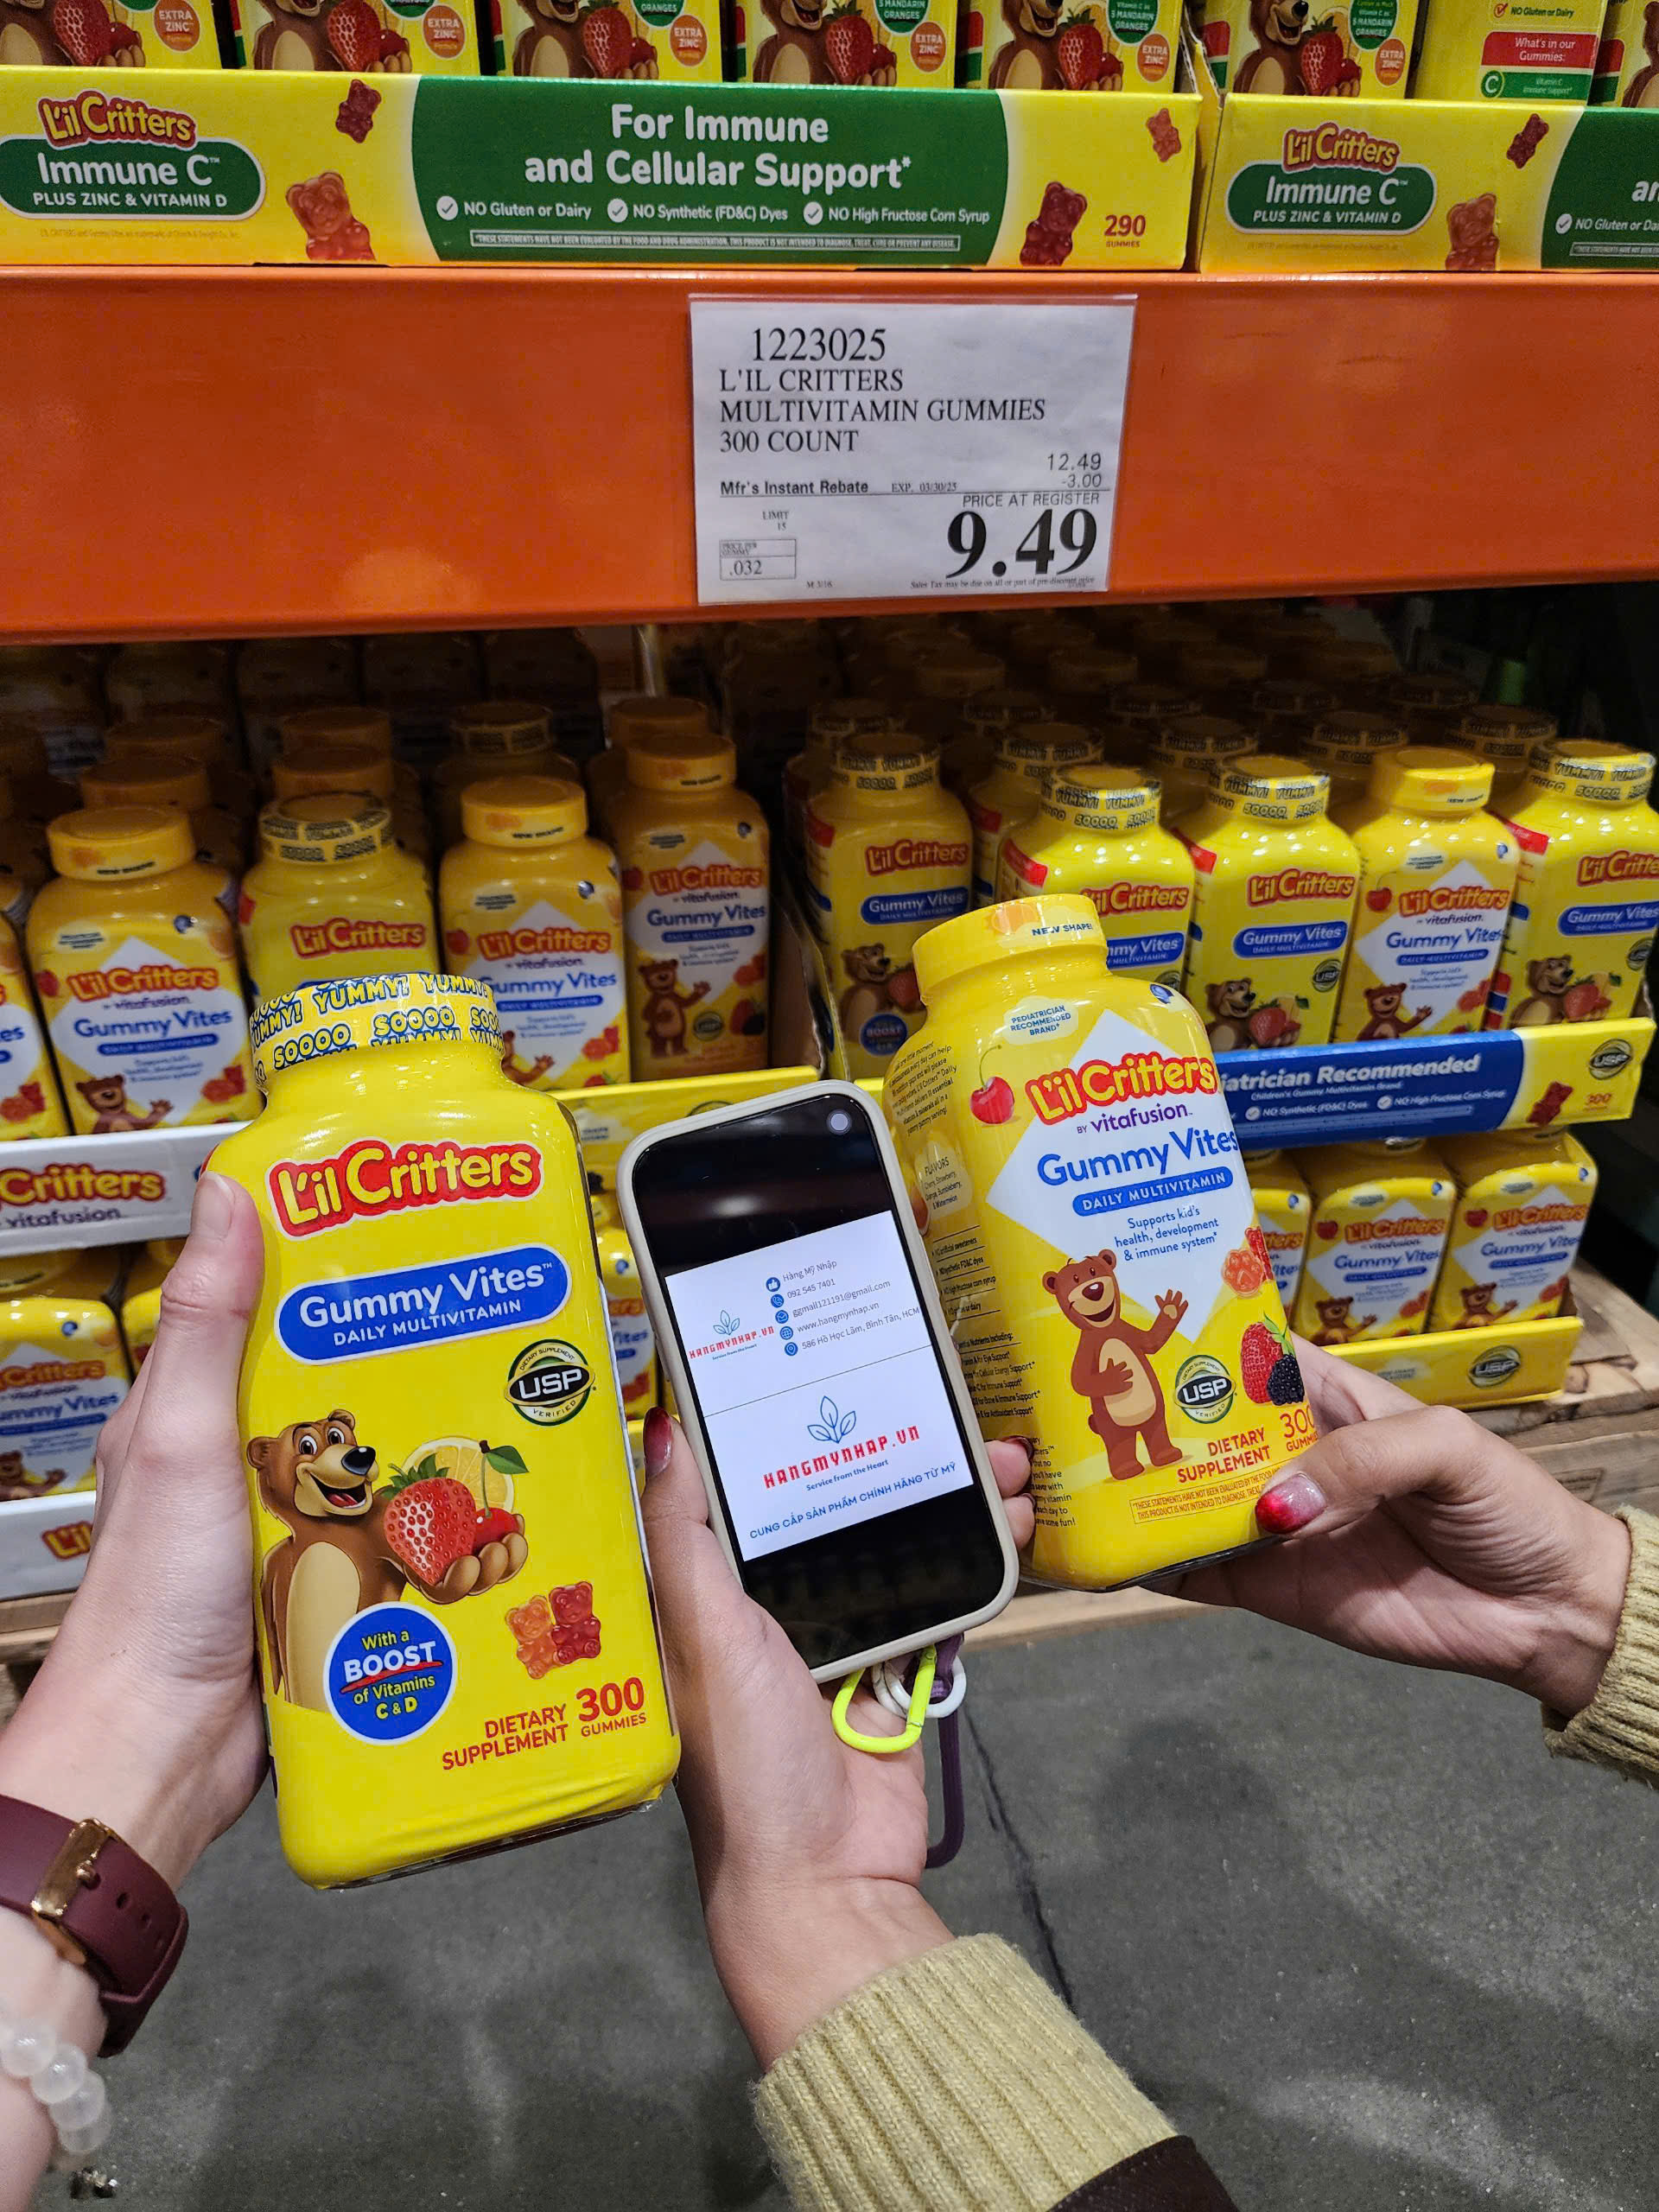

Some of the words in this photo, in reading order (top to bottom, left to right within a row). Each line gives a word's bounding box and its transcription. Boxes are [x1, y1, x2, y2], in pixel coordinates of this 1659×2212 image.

[159, 10, 192, 22] EXTRA
[1516, 38, 1546, 48] What's
[1548, 40, 1557, 48] in
[1520, 51, 1566, 61] Gummies:
[1485, 75, 1499, 93] C
[42, 101, 79, 140] L'il
[81, 96, 191, 142] Critters
[612, 104, 674, 138] For
[685, 106, 828, 142] Immune
[1314, 128, 1398, 165] Critters
[38, 153, 177, 185] Immune
[525, 149, 594, 184] and
[606, 151, 744, 187] Cellular
[33, 193, 76, 206] PLUS
[82, 193, 120, 207] ZINC
[125, 194, 137, 207] &
[143, 194, 211, 207] VITAMIN
[216, 194, 226, 207] D
[1267, 177, 1372, 205] Immune
[464, 201, 486, 216] NO
[490, 202, 534, 217] Gluten
[538, 206, 552, 217] or
[556, 203, 591, 220] Dairy
[633, 205, 654, 219] NO
[658, 205, 711, 222] Synthetic
[715, 207, 756, 222] (FD&C)
[760, 207, 787, 221] Dyes
[829, 207, 849, 220] NO
[853, 207, 877, 224] High
[881, 208, 926, 222] Fructose
[930, 208, 955, 222] Corn
[958, 208, 989, 225] Syrup
[1103, 214, 1146, 237] 290
[1106, 240, 1140, 249] GUMMIES
[752, 327, 886, 362] 1223025
[721, 369, 771, 392] L'IL
[779, 369, 904, 392] CRITTERS
[720, 399, 918, 423] MULTIVITAMIN
[927, 399, 1046, 421] GUMMIES
[720, 430, 760, 453] 300
[768, 429, 860, 453] COUNT
[1047, 453, 1102, 471] 12.49
[721, 481, 759, 494] Mfr's
[765, 482, 814, 494] Instant
[820, 480, 868, 494] Rebate
[1062, 474, 1102, 488] -3.00
[963, 494, 1002, 507] PRICE
[1008, 494, 1025, 506] AT
[1033, 493, 1099, 505] REGISTER
[762, 511, 789, 520] LIMIT
[946, 509, 1096, 579] 9.49
[729, 560, 762, 575] .032
[894, 842, 966, 867] Critters
[1280, 873, 1354, 898] Critters
[868, 898, 923, 913] Gummy
[926, 892, 964, 906] Vites
[1032, 926, 1059, 936] NEW
[1063, 923, 1092, 931] SHAPE!
[1243, 930, 1300, 946] Gummy
[1306, 926, 1341, 938] Vites
[107, 969, 218, 992] Critters
[73, 1018, 171, 1038] Gummy
[173, 1010, 232, 1027] Vites
[373, 1005, 455, 1038] SOOOO
[1010, 1013, 1071, 1031] RECOMMENDED
[1012, 1005, 1065, 1024] PEDIATRICIAN
[1317, 1054, 1480, 1085] Recommended
[1031, 1072, 1082, 1119] L'il
[1082, 1057, 1215, 1101] Critters
[1077, 1125, 1087, 1134] BY
[1038, 1143, 1169, 1185] Gummy
[1169, 1128, 1237, 1160] Vites
[1, 1168, 163, 1205] Critters
[277, 1162, 341, 1226] L'il
[346, 1147, 533, 1205] Critters
[1082, 1192, 1122, 1211] DAILY
[1128, 1172, 1225, 1201] MULTIVITAMIN
[7, 1207, 121, 1229] vitafusion
[1128, 1213, 1175, 1230] Supports
[1177, 1205, 1200, 1219] kid's
[1115, 1232, 1154, 1248] health,
[1155, 1218, 1219, 1239] development
[1124, 1249, 1133, 1261] &
[1136, 1243, 1179, 1258] immune
[783, 1269, 804, 1281] Hàng
[787, 1289, 801, 1299] 092
[803, 1285, 817, 1294] 545
[818, 1279, 836, 1289] 7401
[299, 1283, 444, 1329] Gummy
[797, 1302, 880, 1332] www.hangmynhap.vn
[334, 1325, 388, 1346] DAILY
[392, 1299, 521, 1335] MULTIVITAMIN
[802, 1339, 816, 1349] 586
[902, 1307, 919, 1319] HCM
[690, 1325, 774, 1359] HANGMYNHAP.VN
[520, 1351, 537, 1370] DIETARY
[539, 1348, 575, 1360] SUPPLEMENT
[518, 1369, 582, 1399] USP
[1183, 1378, 1227, 1402] USP
[533, 1400, 575, 1417] VERIFIED
[1207, 1427, 1265, 1457] DIETARY
[763, 1426, 919, 1489] HANGMYNHAP.VN
[1177, 1446, 1271, 1483] SUPPLEMENT
[807, 1478, 832, 1491] Service
[834, 1471, 853, 1482] from
[854, 1467, 867, 1477] the
[867, 1459, 888, 1471] Heart
[750, 1522, 780, 1539] CUNG
[362, 1632, 394, 1650] With
[401, 1630, 410, 1642] a
[343, 1641, 436, 1683] BOOST
[353, 1689, 370, 1705] of
[372, 1674, 435, 1700] Vitamins
[376, 1701, 388, 1719] C
[391, 1701, 401, 1715] &
[404, 1696, 418, 1713] D
[484, 1703, 567, 1738] DIETARY
[575, 1677, 645, 1723] 300
[442, 1724, 569, 1770] SUPPLEMENT
[581, 1712, 647, 1738] GUMMIES
